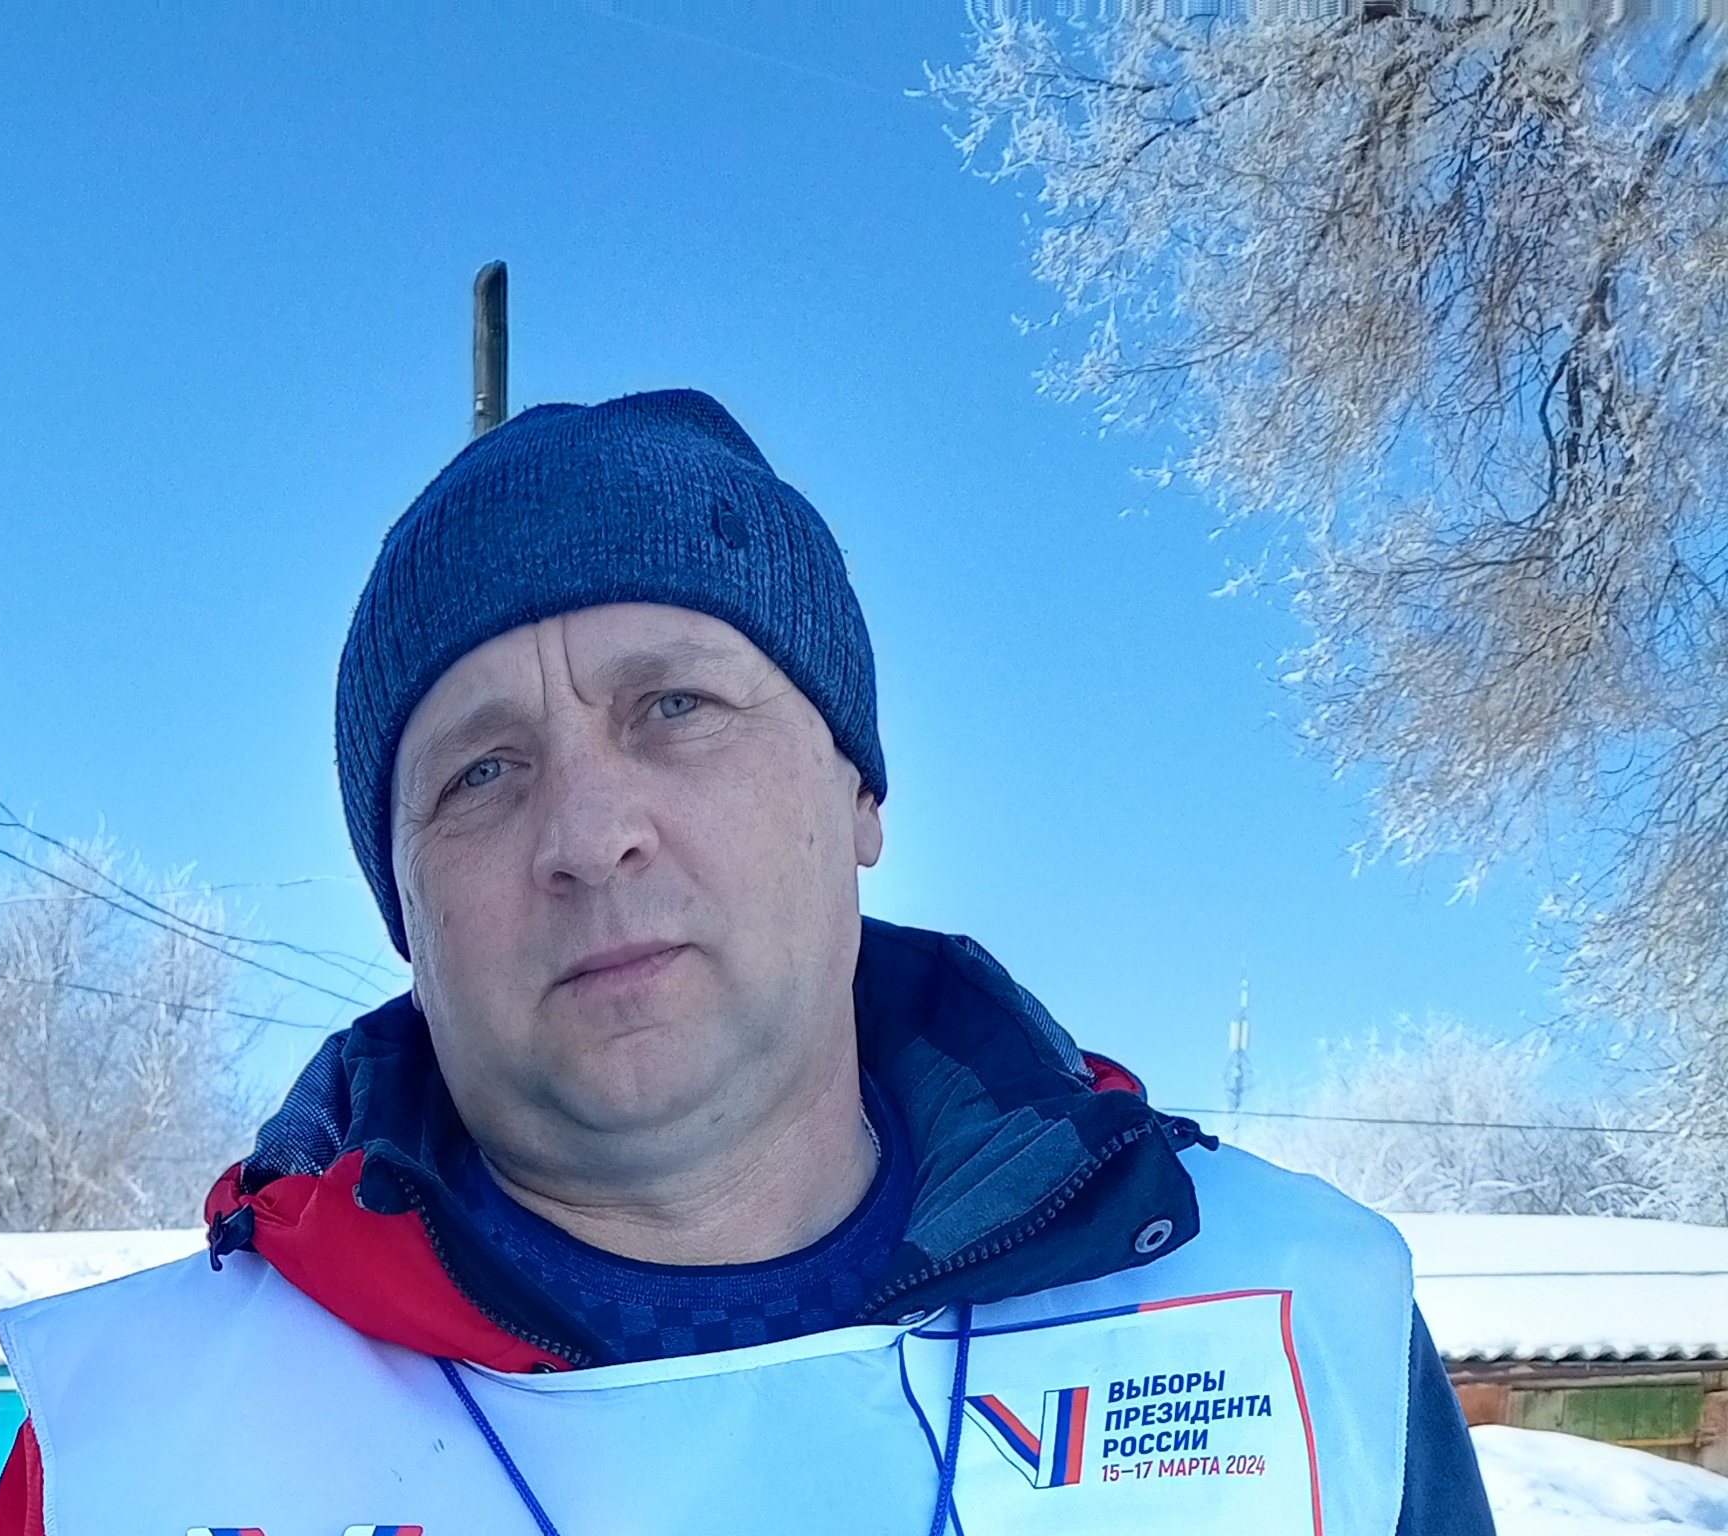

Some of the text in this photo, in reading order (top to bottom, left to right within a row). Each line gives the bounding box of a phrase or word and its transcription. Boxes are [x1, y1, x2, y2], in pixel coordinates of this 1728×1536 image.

[1108, 1370, 1225, 1403] ВЫБОРЫ
[1104, 1395, 1272, 1431] ПРЕЗИДЕНТА
[1102, 1429, 1208, 1458] РОССИИ
[1158, 1456, 1221, 1478] МАРТА
[1225, 1455, 1266, 1476] 2024
